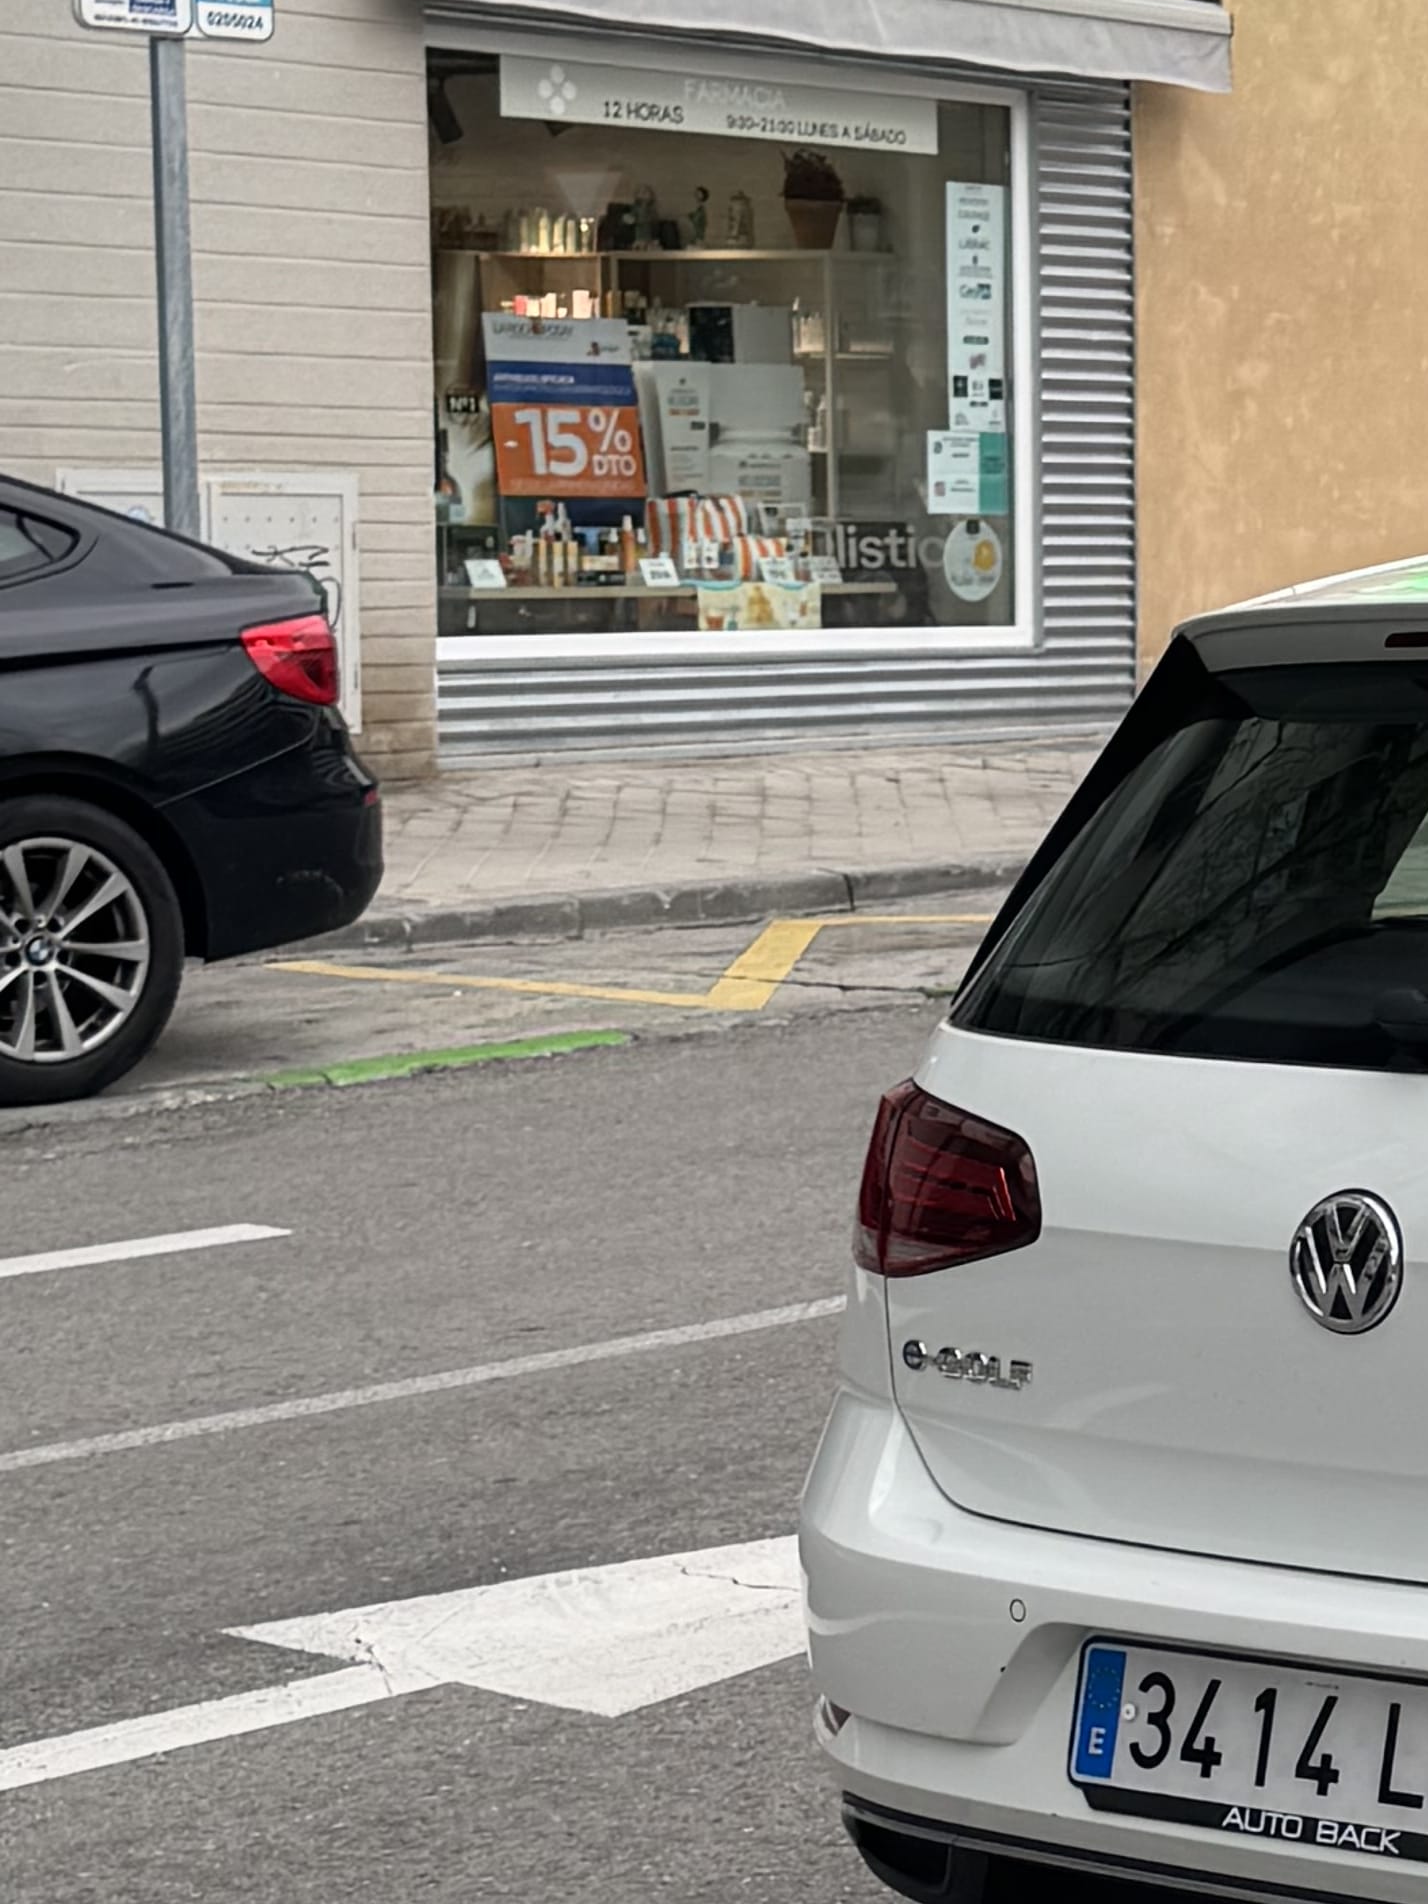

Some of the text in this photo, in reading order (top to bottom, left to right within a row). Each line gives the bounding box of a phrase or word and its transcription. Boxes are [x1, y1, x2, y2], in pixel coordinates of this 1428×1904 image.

[684, 79, 787, 109] FARMACIA
[603, 101, 685, 125] 12 HORAS
[592, 454, 637, 477] DTO
[1086, 1726, 1107, 1756] E
[1129, 1671, 1340, 1797] 3414
[1221, 1806, 1401, 1856] AUTO BACK
